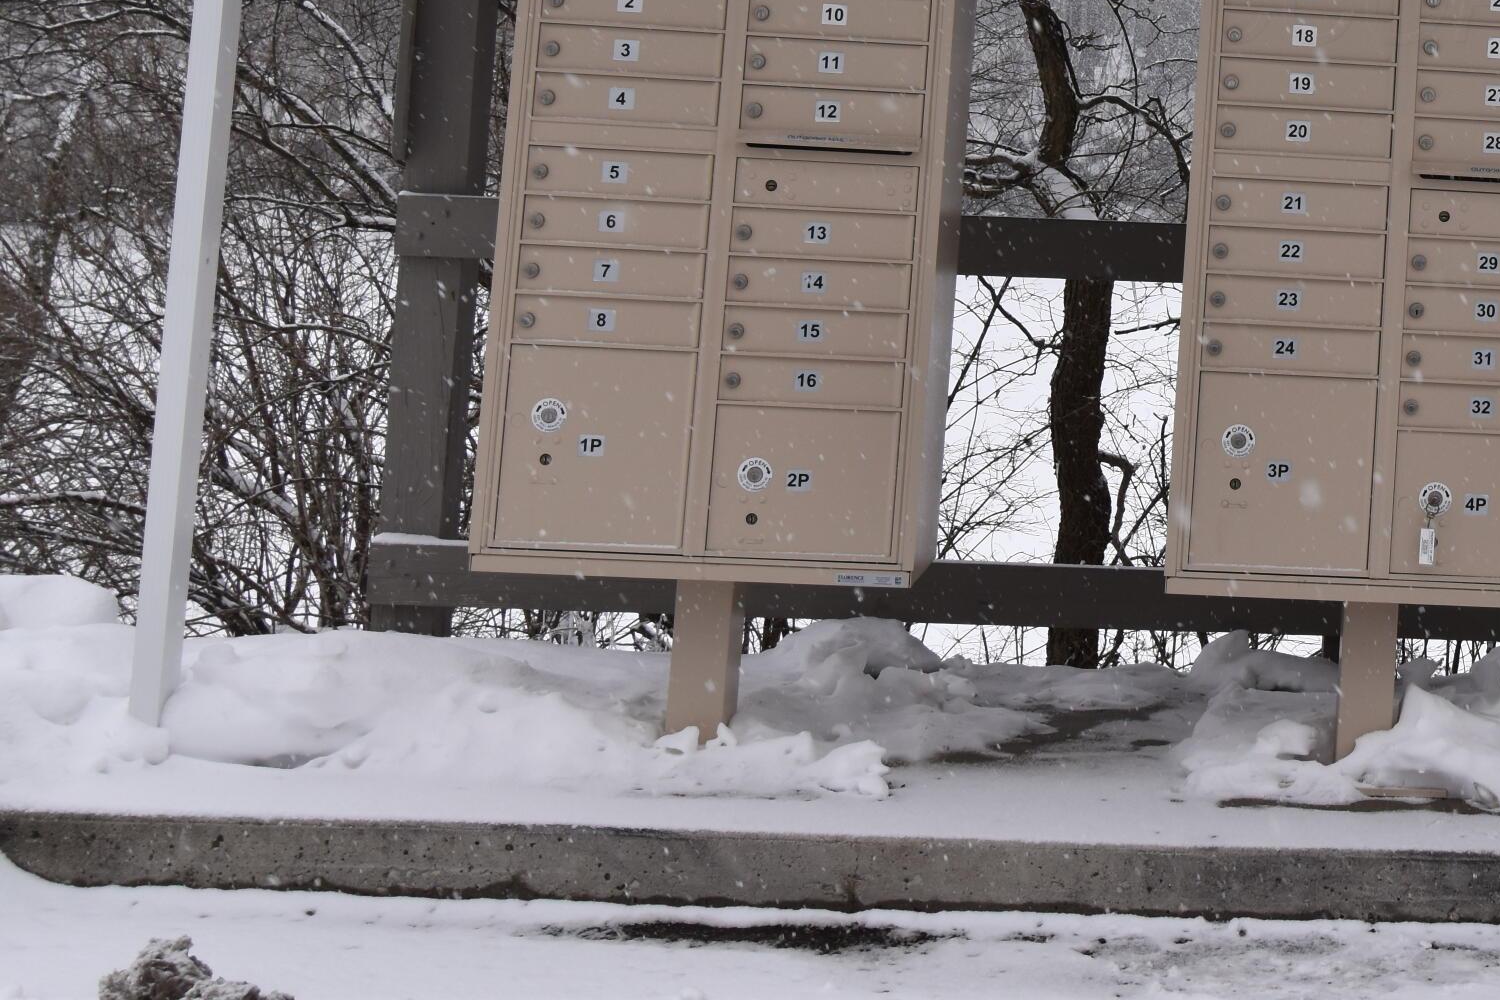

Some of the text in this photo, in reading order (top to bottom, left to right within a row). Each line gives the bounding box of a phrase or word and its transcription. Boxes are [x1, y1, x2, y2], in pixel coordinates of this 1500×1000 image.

[825, 7, 844, 22] 10
[1295, 29, 1314, 43] 18
[620, 43, 631, 57] 3
[822, 55, 839, 70] 11
[1292, 76, 1311, 91] 19
[615, 91, 626, 106] 4
[818, 104, 837, 119] 12
[1288, 124, 1308, 138] 20
[609, 165, 620, 179] 5
[1283, 195, 1302, 210] 21
[606, 214, 616, 229] 6
[807, 225, 827, 240] 13
[1281, 244, 1301, 258] 22
[601, 263, 611, 278] 7
[1479, 256, 1498, 270] 29
[804, 274, 824, 289] 14
[1278, 292, 1298, 307] 23
[1476, 303, 1496, 318] 30
[596, 312, 607, 327] 8
[800, 323, 820, 338] 15
[1275, 340, 1295, 355] 24
[1474, 351, 1491, 366] 31
[797, 373, 817, 388] 16
[542, 400, 562, 409] OPEN
[1471, 400, 1491, 415] 32
[1231, 426, 1250, 435] OPEN
[580, 438, 602, 453] 1P
[748, 459, 766, 468] OPEN
[1267, 463, 1289, 478] 3P
[787, 473, 810, 488] 2P
[1427, 484, 1446, 493] OPEN
[1465, 497, 1487, 512] 4P
